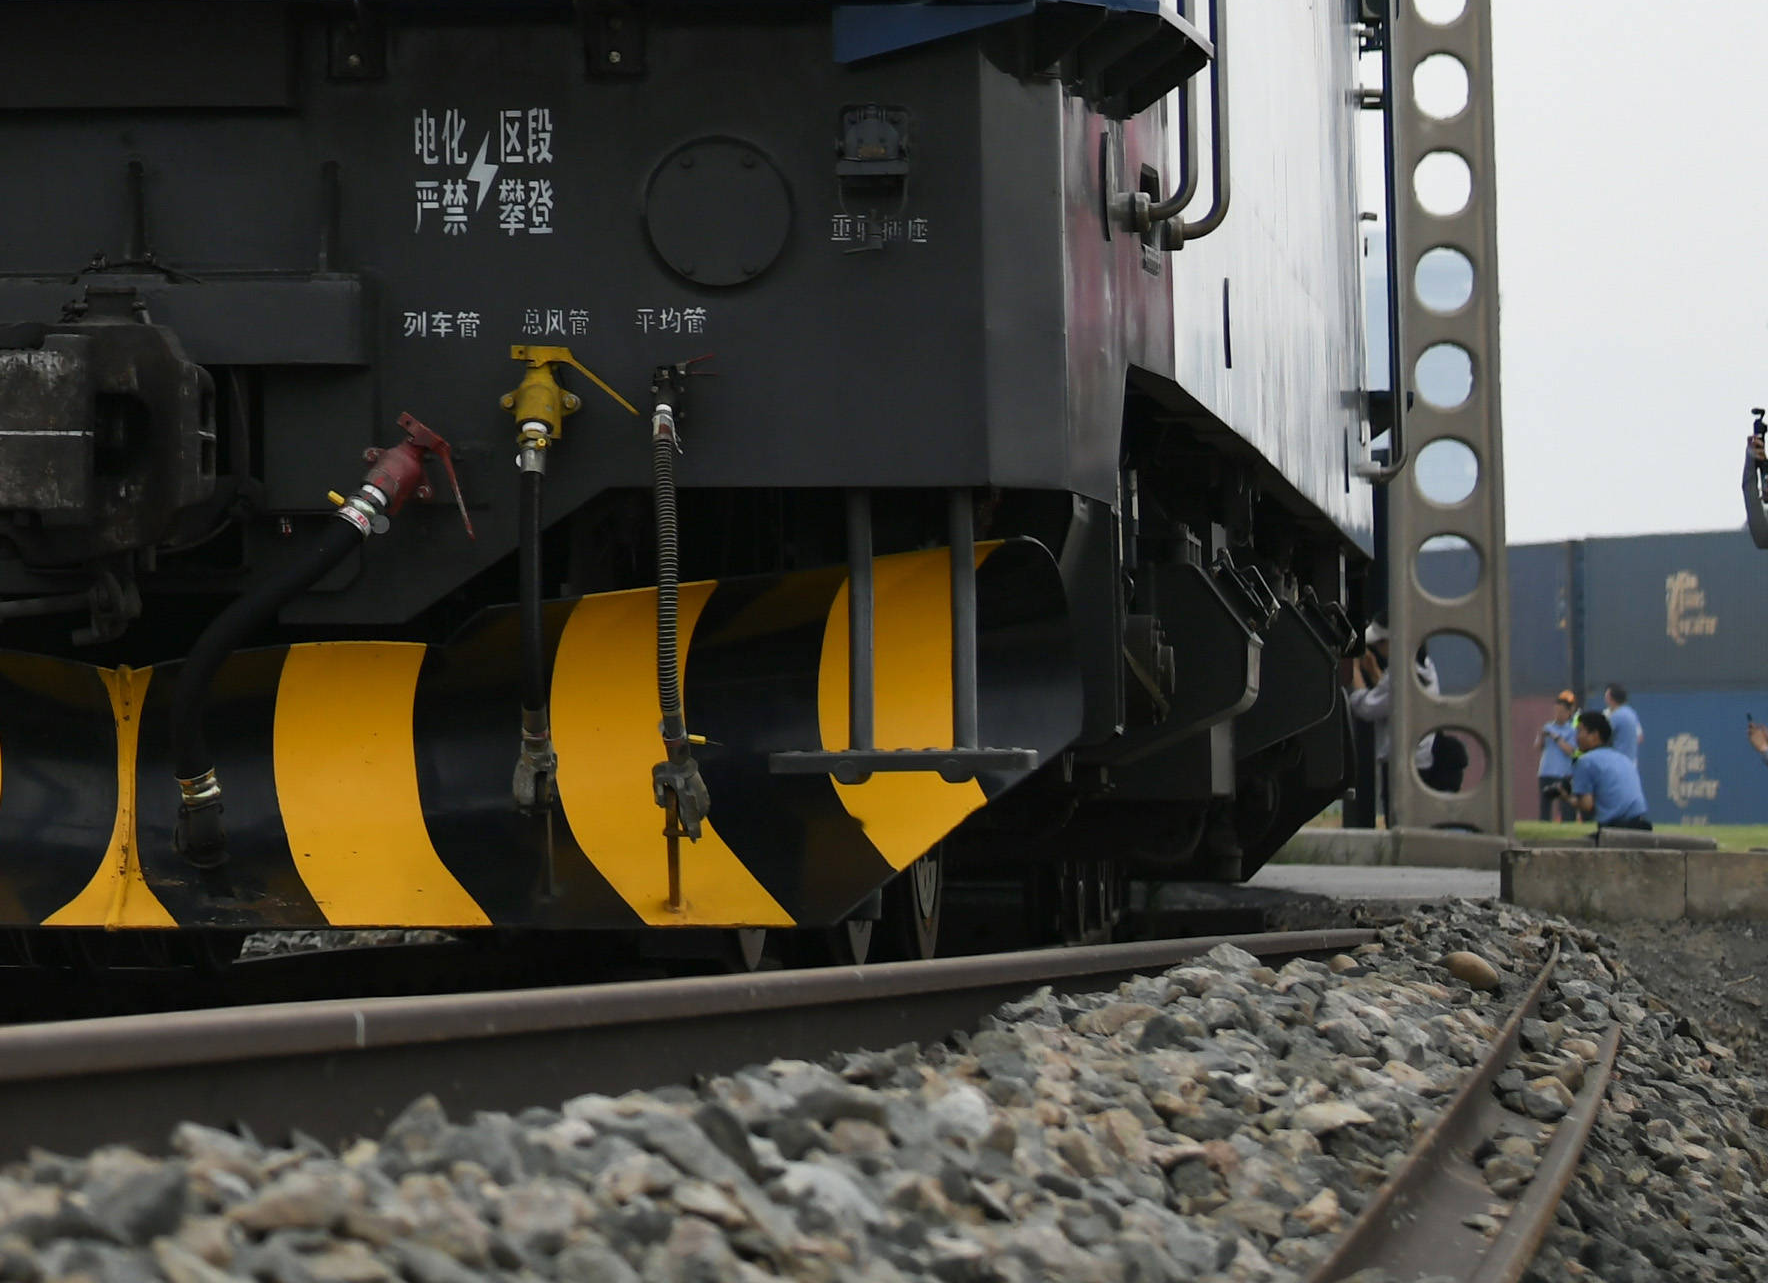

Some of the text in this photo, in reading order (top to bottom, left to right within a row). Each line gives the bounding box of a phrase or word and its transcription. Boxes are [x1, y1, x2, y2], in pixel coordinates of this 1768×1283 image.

[403, 306, 708, 338] 列车管 总风管 平均管
